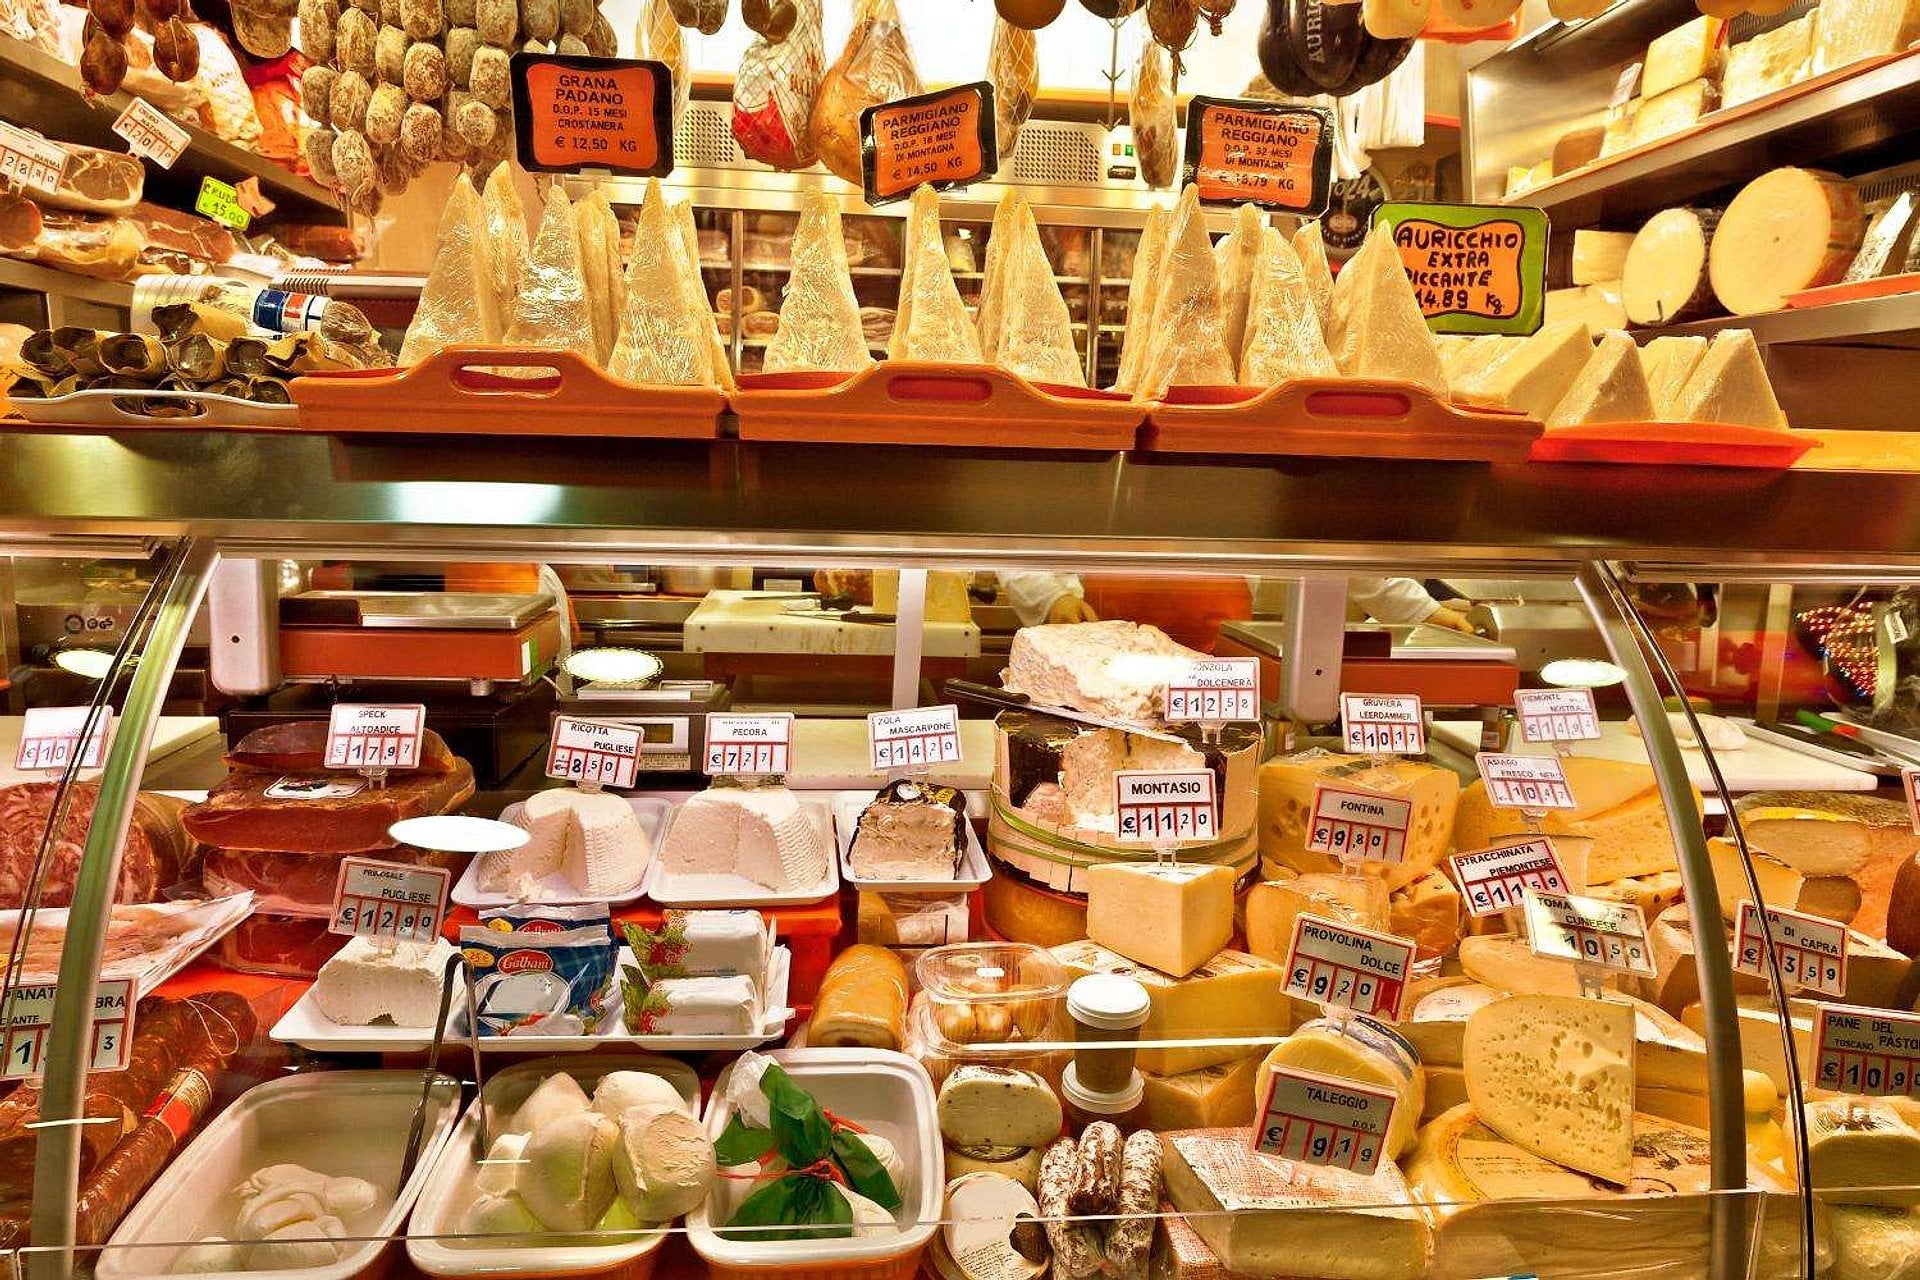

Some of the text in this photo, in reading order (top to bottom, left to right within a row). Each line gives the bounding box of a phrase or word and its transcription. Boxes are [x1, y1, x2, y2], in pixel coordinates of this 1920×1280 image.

[560, 75, 617, 90] GRANA
[555, 88, 623, 105] PADANO
[588, 108, 600, 117] 15
[604, 109, 627, 118] MESI
[883, 102, 969, 130] PARMIGIANO
[558, 118, 624, 132] CROSTANERA
[891, 116, 960, 140] REGGIANO
[1215, 112, 1310, 135] PARMIGIANO
[936, 130, 957, 142] MESI
[1221, 128, 1298, 147] REGGIANO
[555, 136, 565, 148] €
[619, 140, 637, 153] KG
[896, 143, 955, 162] DI MONTAGNA
[947, 156, 963, 168] KG
[1278, 178, 1295, 190] KG
[1396, 226, 1518, 249] AURICCHIO
[1427, 251, 1489, 268] EXTRA
[358, 710, 386, 719] SPECK
[570, 723, 609, 736] RICOTTA
[732, 728, 768, 736] PECORA
[889, 722, 951, 735] MASCARPONE
[593, 741, 635, 754] PUGLIESE
[1131, 782, 1201, 794] MONTASIO
[1340, 800, 1384, 816] FONTINA
[1457, 845, 1534, 867] STRACCHINATA
[1489, 857, 1553, 876] PIEMONTESE
[381, 888, 431, 904] PUGLIESE
[1537, 897, 1573, 911] TOMA
[1565, 915, 1617, 932] CUNEESE
[1784, 926, 1795, 937] DI
[1304, 925, 1372, 952] PROVOLINA
[1801, 937, 1838, 955] CAPRA
[1360, 954, 1400, 974] DOLCE
[95, 995, 125, 1009] BRA
[1828, 1015, 1893, 1034] PANE DEL
[1834, 1038, 1874, 1050] TOSCANO
[1307, 1086, 1369, 1110] TALEGGIO
